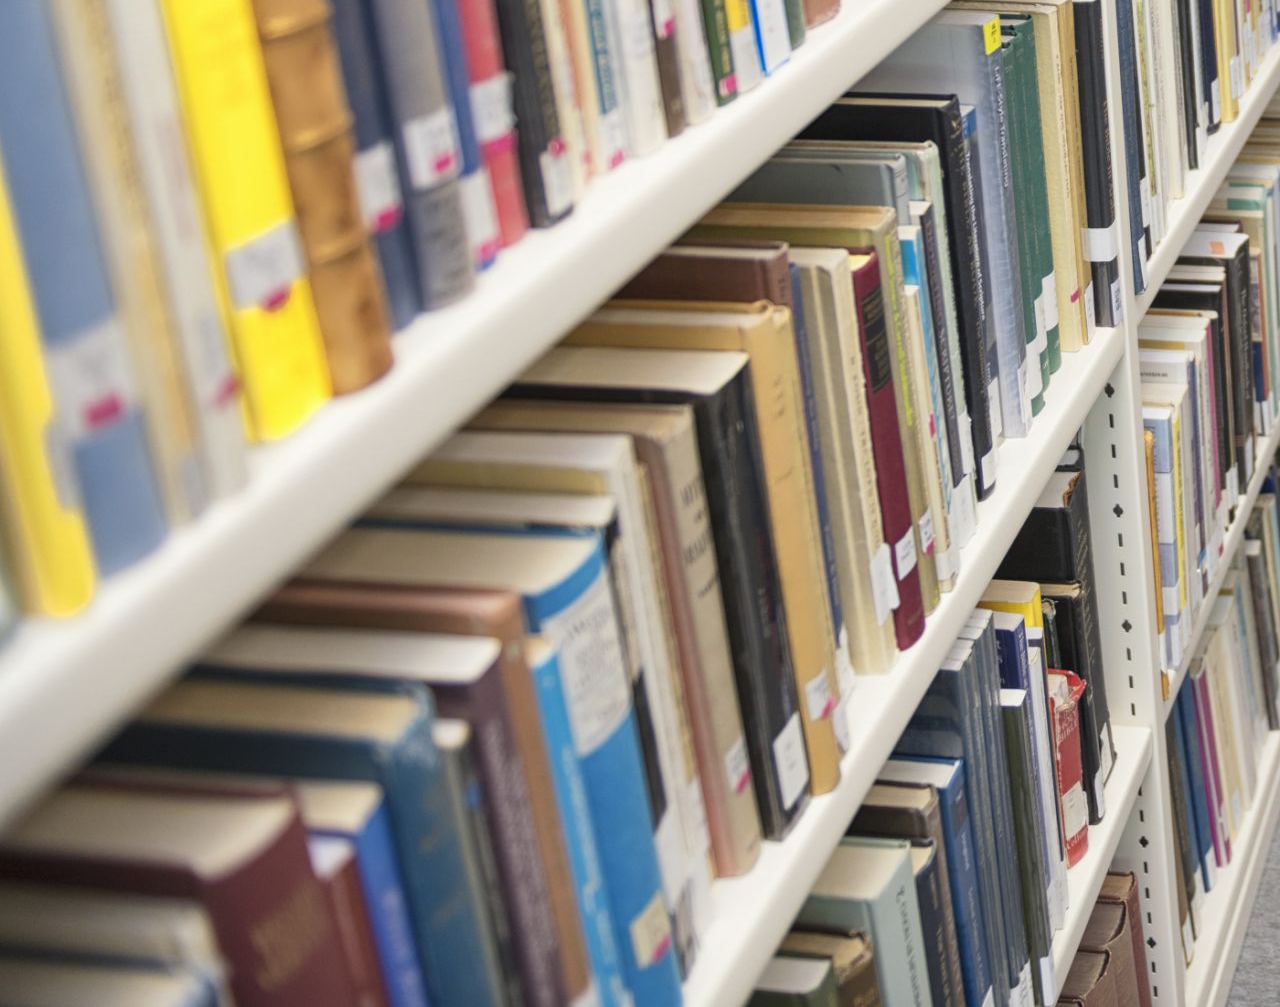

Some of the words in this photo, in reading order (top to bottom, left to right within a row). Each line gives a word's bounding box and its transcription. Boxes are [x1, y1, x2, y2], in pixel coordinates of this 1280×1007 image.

[961, 151, 977, 205] Translating
[998, 125, 1009, 188] Translating
[969, 204, 977, 221] the
[969, 221, 983, 267] Literature
[975, 267, 983, 279] of
[974, 278, 989, 320] Scripture
